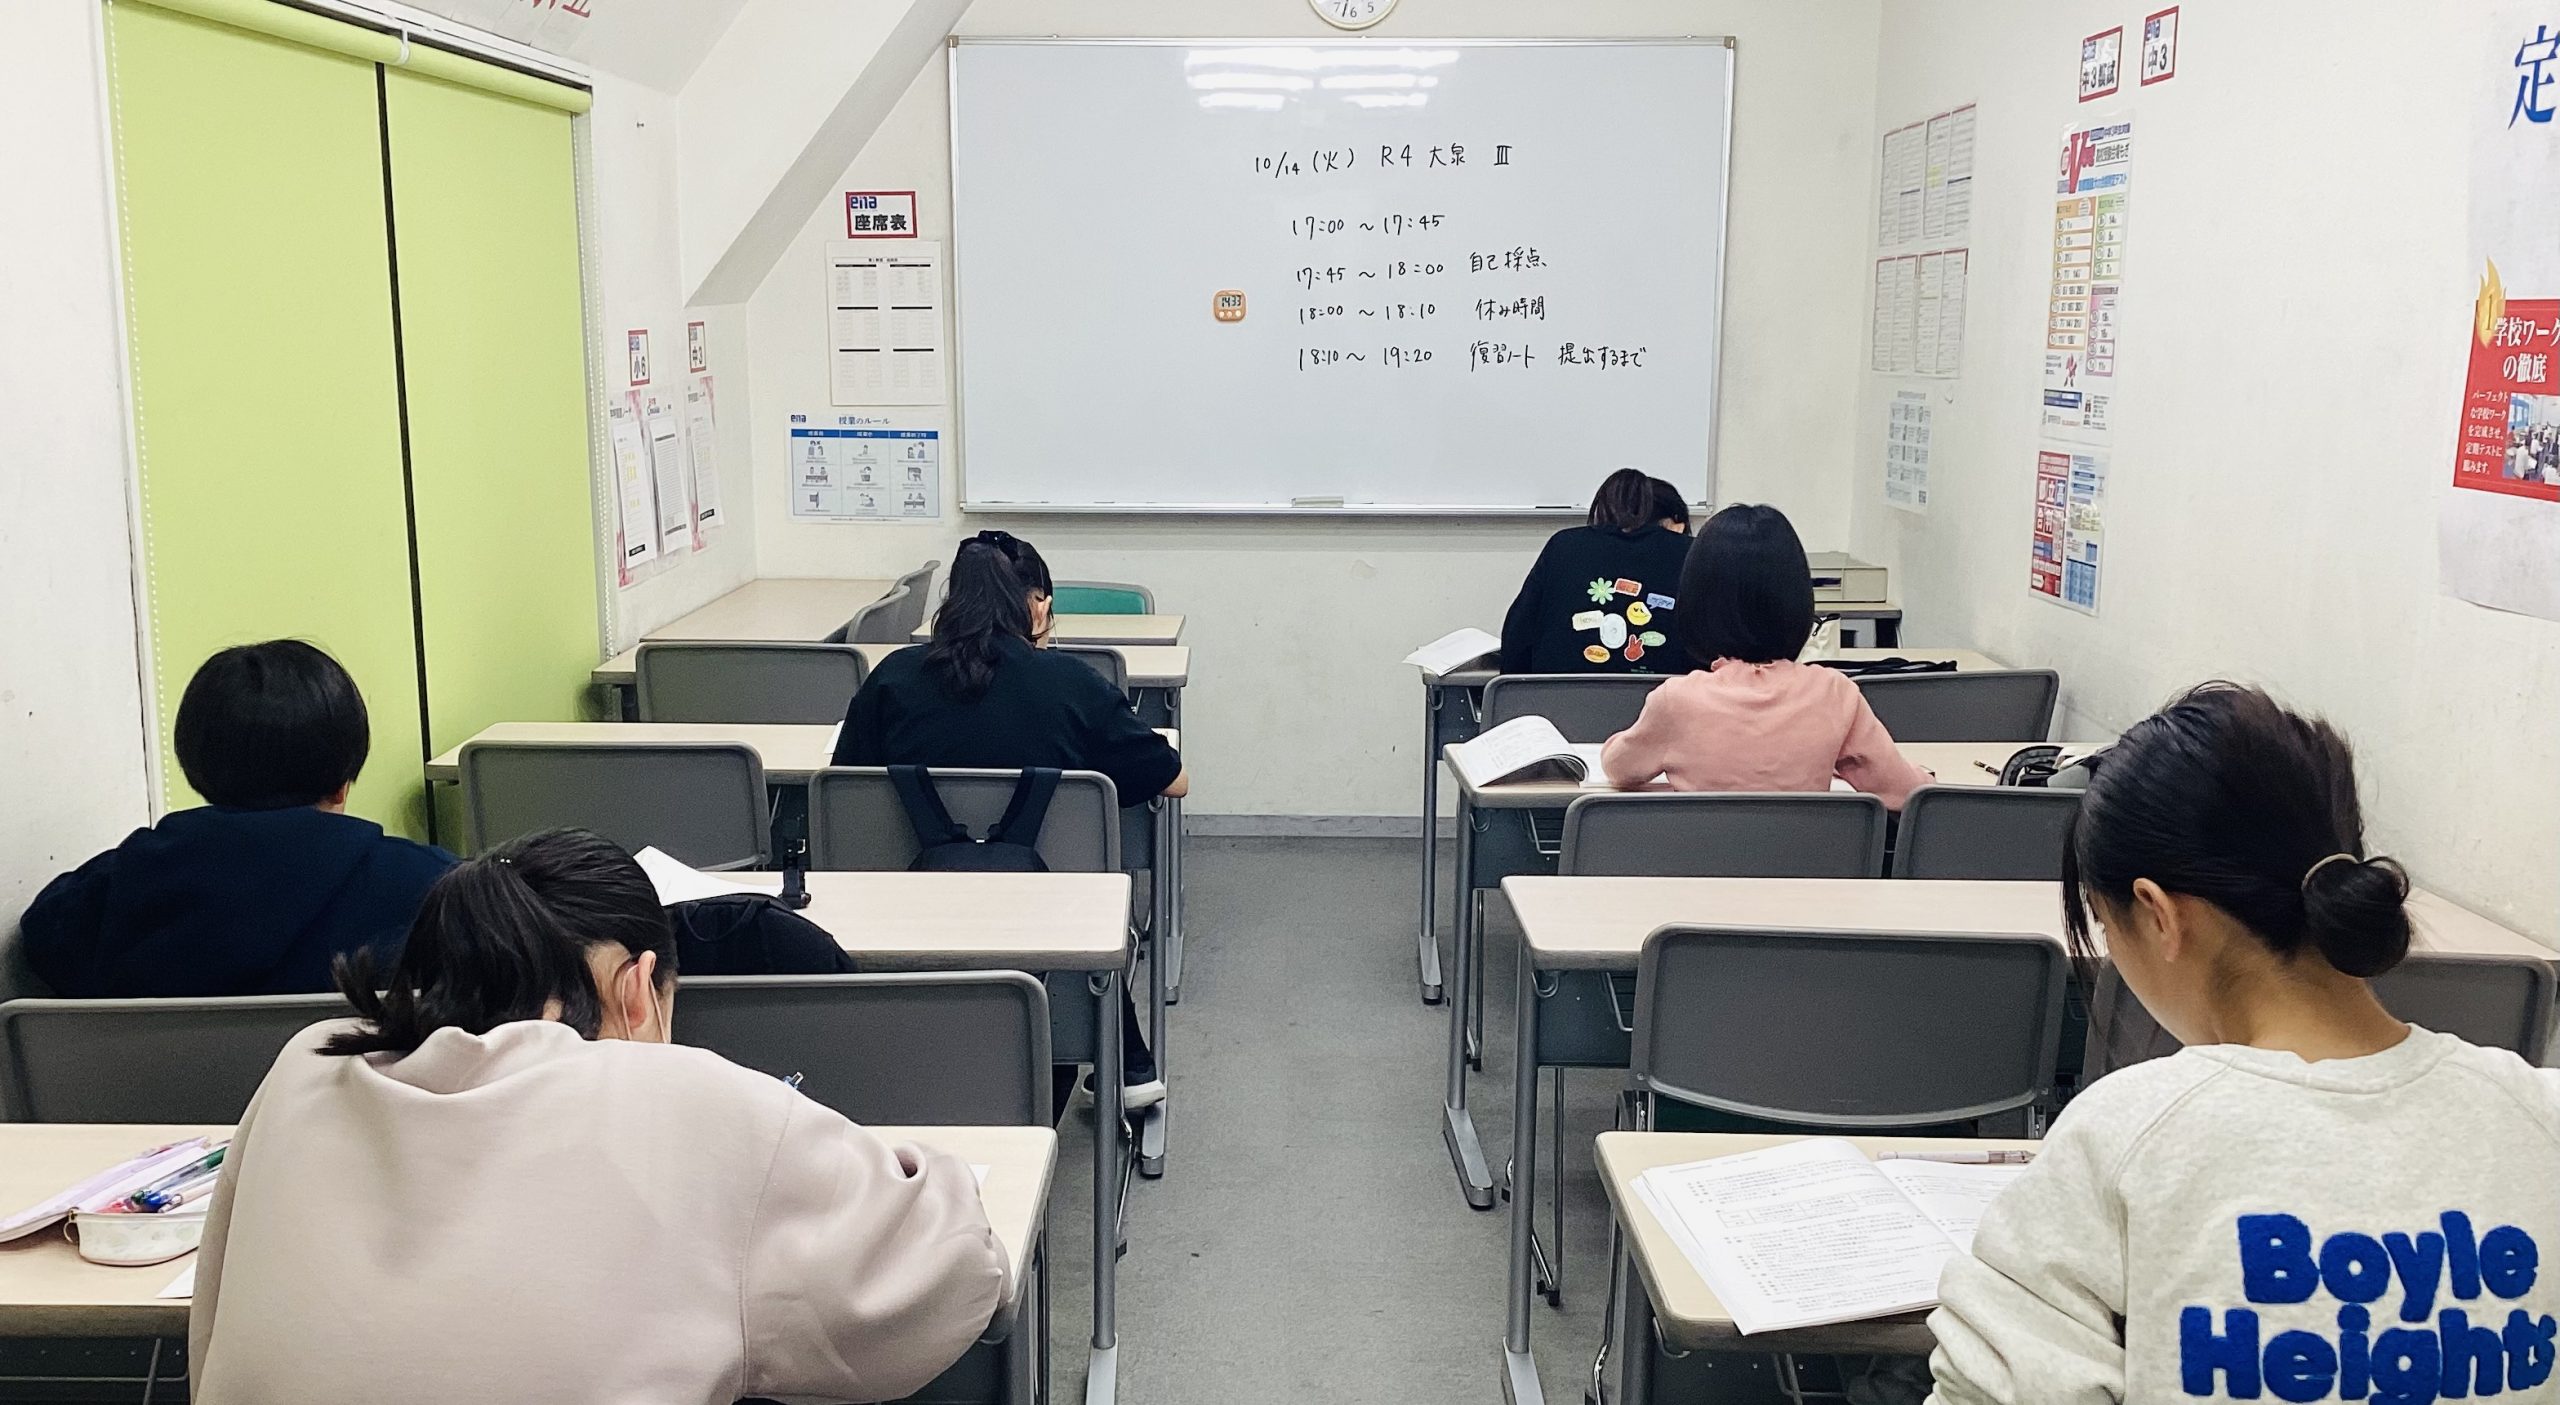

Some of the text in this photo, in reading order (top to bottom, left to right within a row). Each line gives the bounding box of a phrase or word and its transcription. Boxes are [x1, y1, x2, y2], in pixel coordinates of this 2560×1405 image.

[1350, 6, 1358, 18] 6
[1367, 2, 1374, 13] 5
[2147, 43, 2168, 76] 中3
[1255, 151, 1301, 179] 10/14
[1380, 143, 1413, 168] R4
[1428, 143, 1466, 168] 大泉
[850, 196, 877, 209] ena
[855, 214, 907, 231] 座席表
[1292, 215, 1345, 241] 17:00
[1383, 214, 1446, 237] 17:45
[1296, 266, 1347, 290] 17:45
[1388, 261, 1444, 280] 18:00
[1299, 304, 1344, 325] 18:00
[1385, 303, 1436, 321] 18:10
[1474, 295, 1545, 321] 休み時間
[633, 355, 646, 379] 小6
[1299, 347, 1339, 372] 18:10
[1383, 346, 1433, 369] 19:20
[1469, 339, 1536, 373] 復習ノート
[1557, 342, 1647, 371] 提出するまで
[2503, 353, 2547, 383] の徹底
[2237, 1210, 2538, 1323] Boyle
